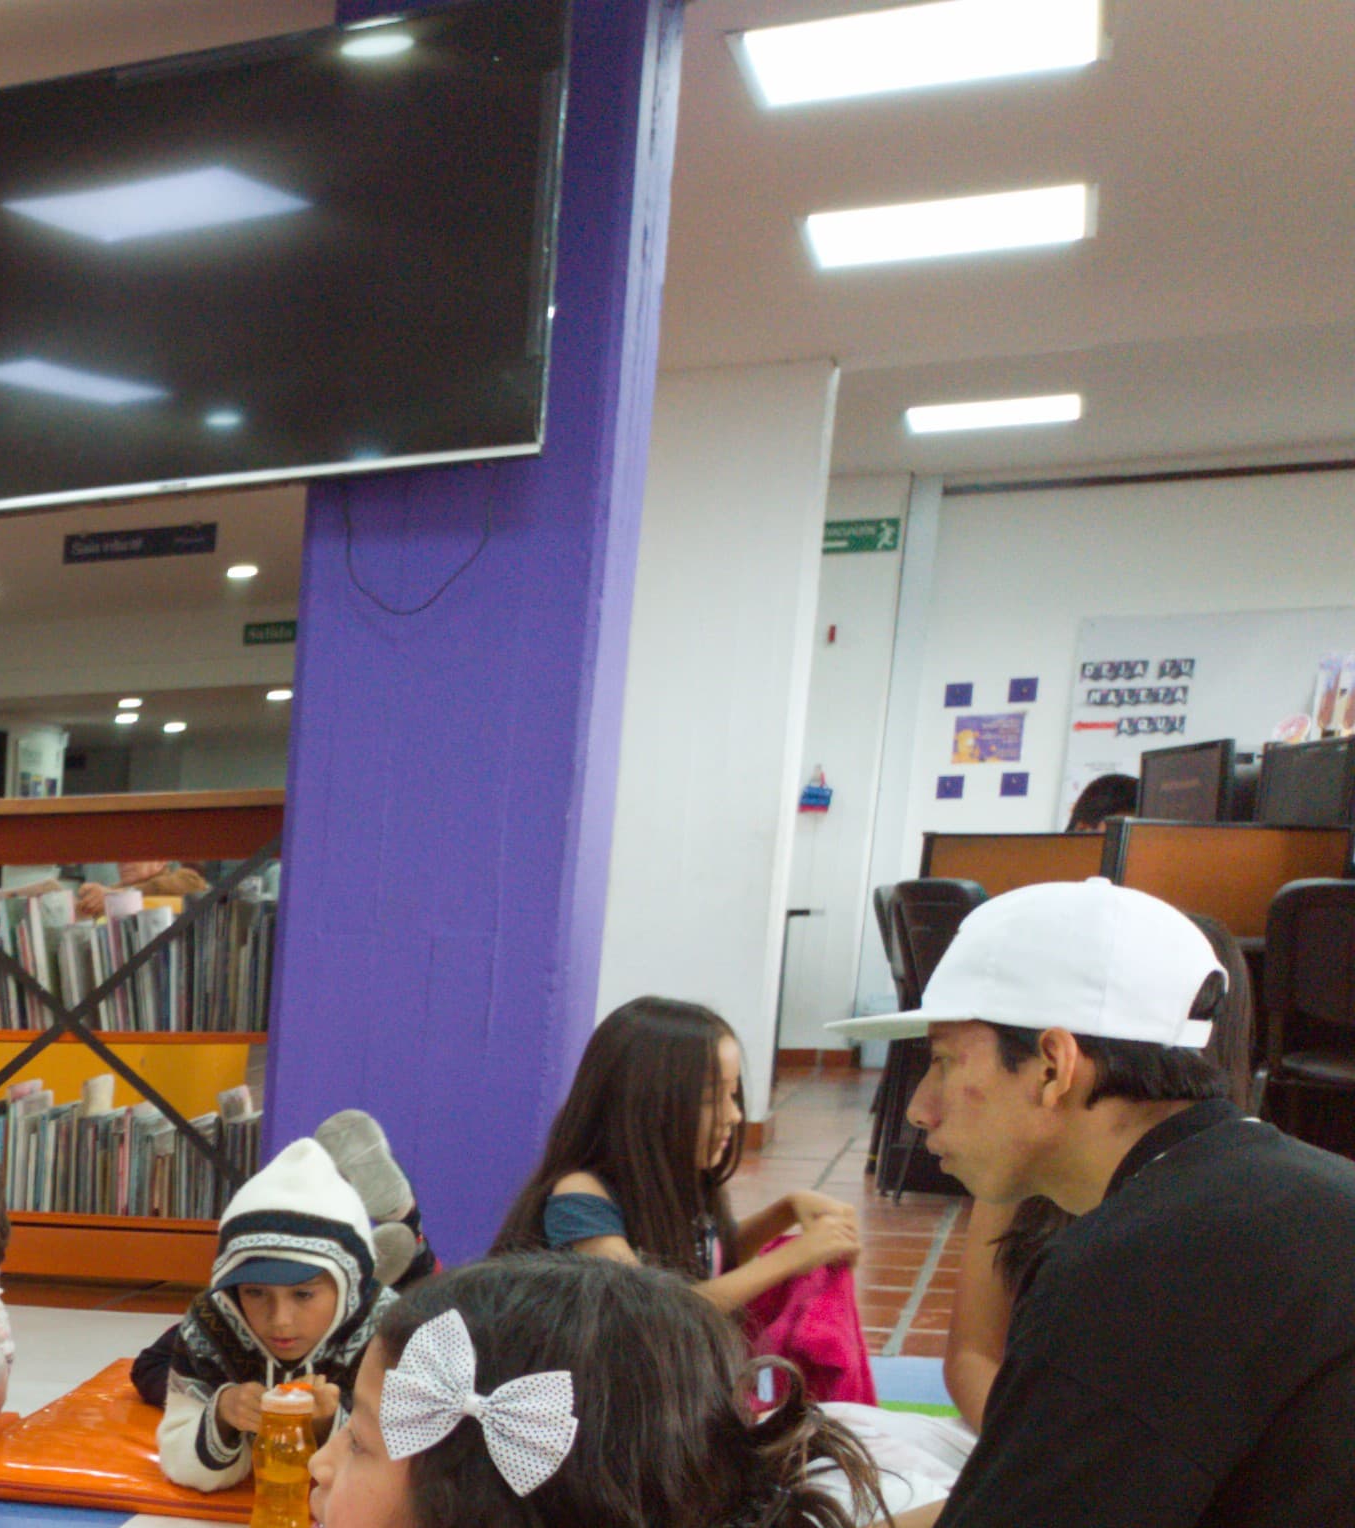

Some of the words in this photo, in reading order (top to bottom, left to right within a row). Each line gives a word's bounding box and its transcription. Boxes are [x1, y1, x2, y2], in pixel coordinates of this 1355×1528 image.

[1082, 660, 1147, 679] DEJA
[1160, 659, 1193, 677] TU
[1088, 687, 1187, 705] MALETA
